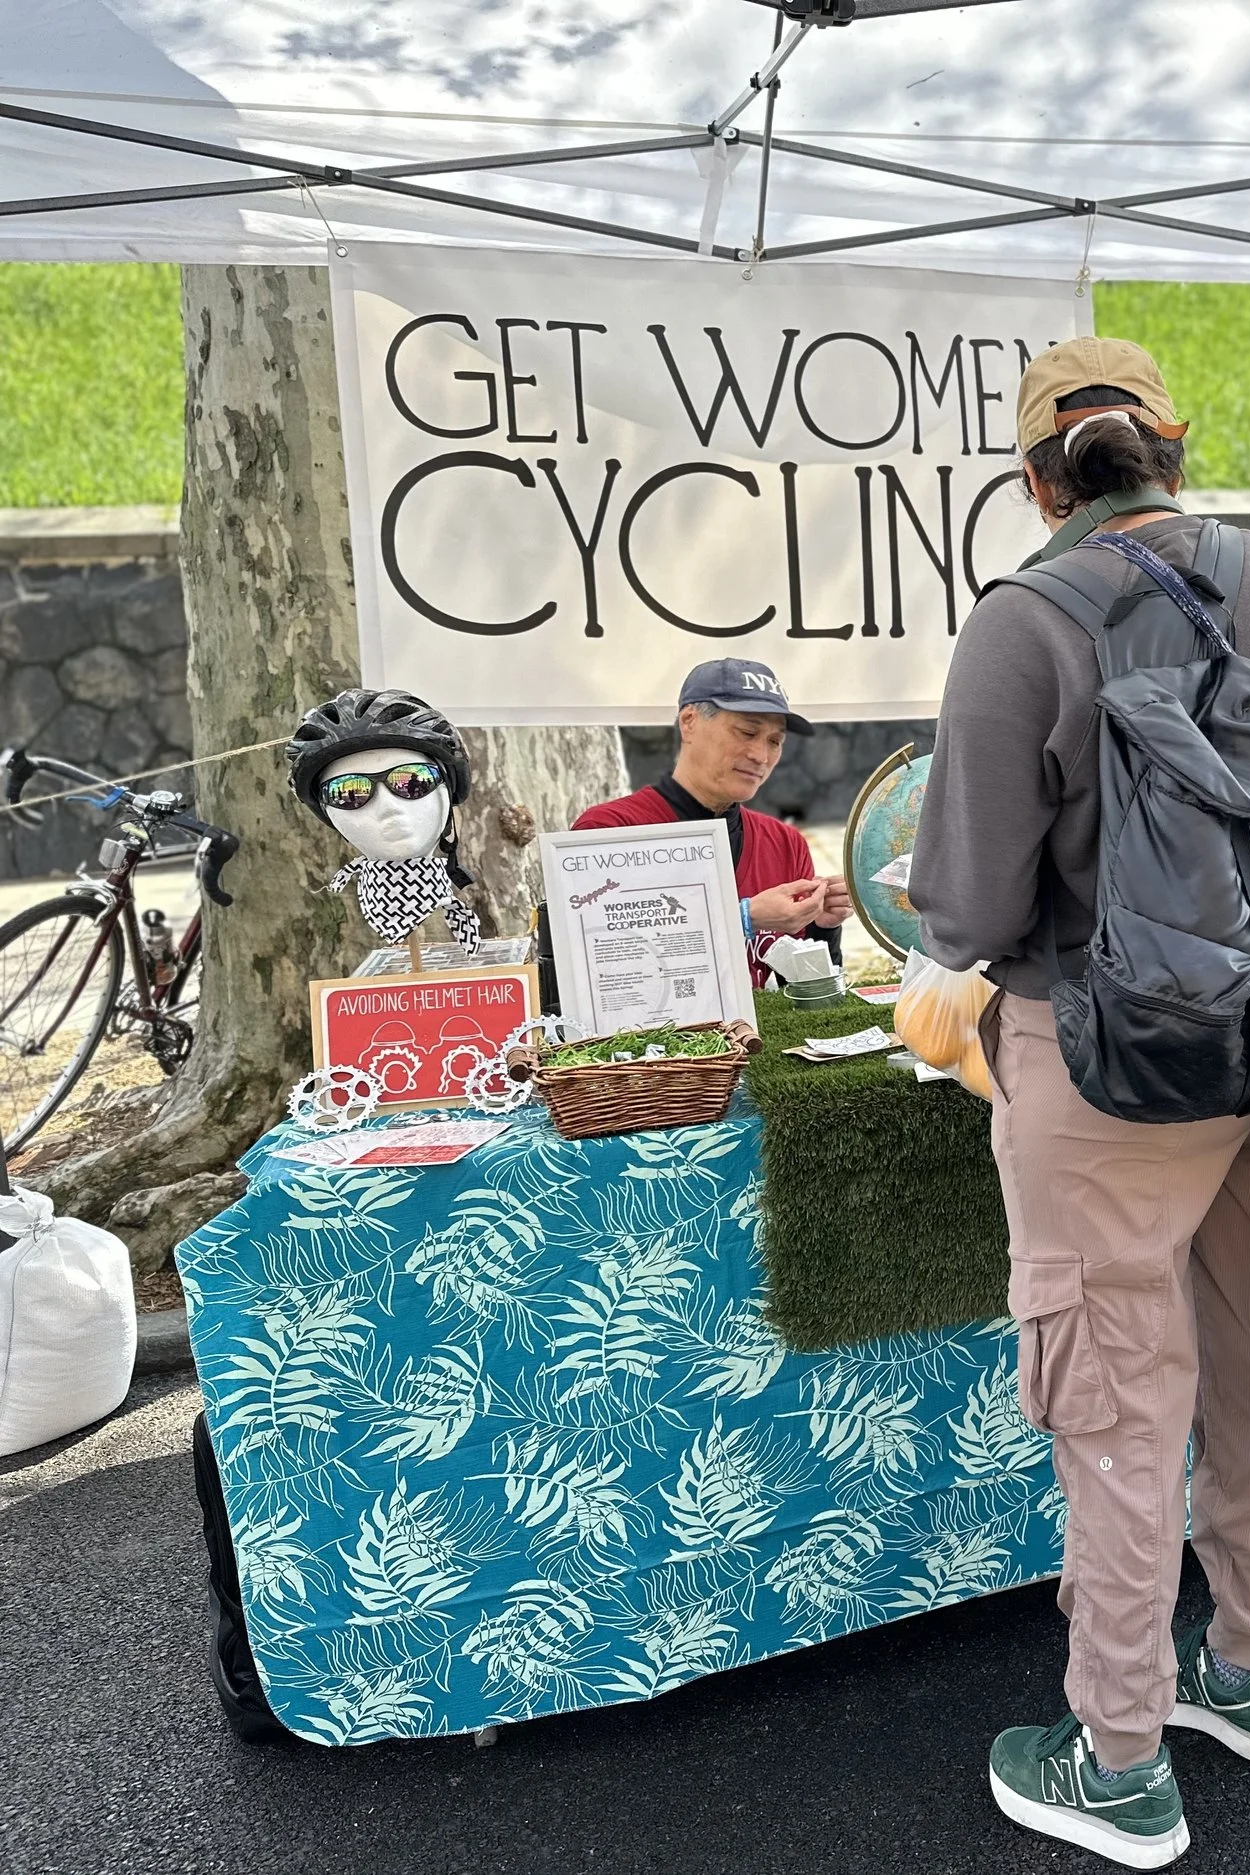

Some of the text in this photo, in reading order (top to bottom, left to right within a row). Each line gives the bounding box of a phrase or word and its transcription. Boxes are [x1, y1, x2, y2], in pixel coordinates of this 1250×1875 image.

[385, 313, 608, 443] GET
[562, 845, 714, 872] GET WOMEN CYCLING
[569, 878, 620, 910] Supports
[603, 898, 663, 912] WORKERS
[605, 907, 667, 921] TRANSPORT
[606, 915, 688, 931] COOPERATIVE
[337, 984, 516, 1016] AVOIDING HELMET HAIR
[1041, 1757, 1078, 1807] N
[1153, 1761, 1168, 1778] new
